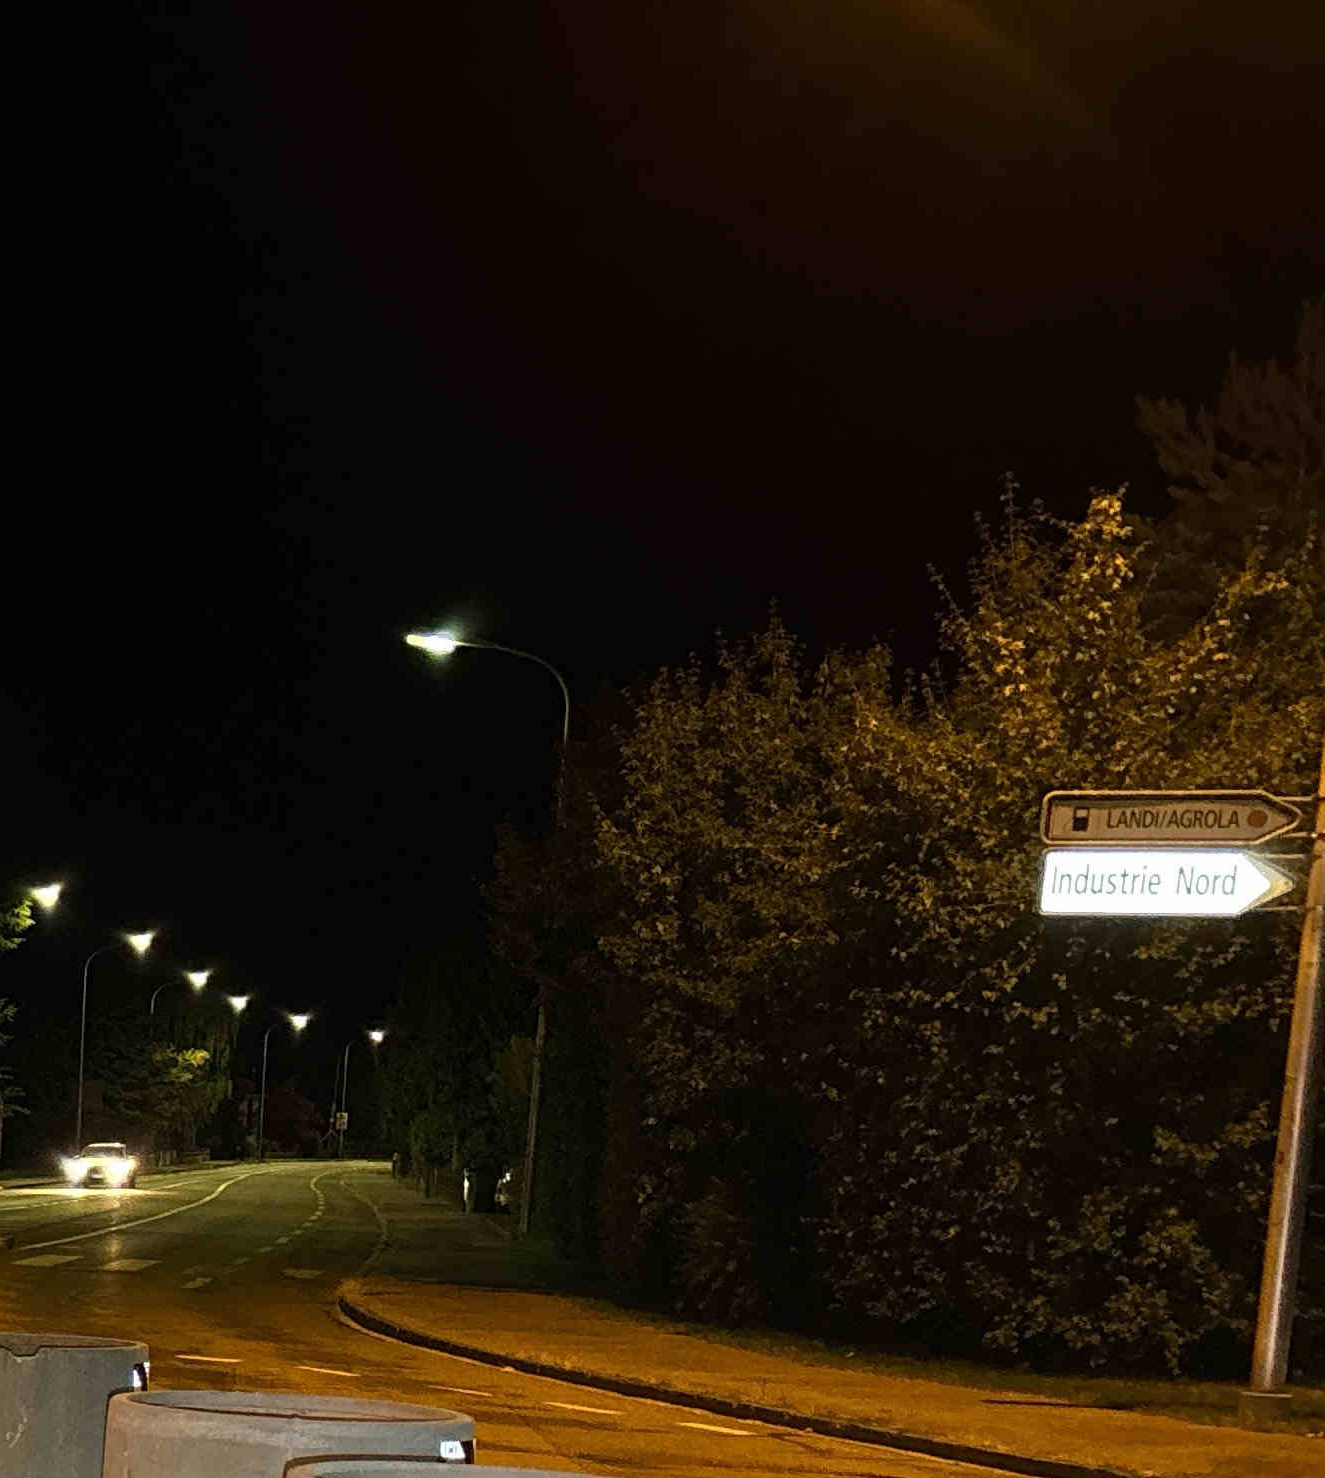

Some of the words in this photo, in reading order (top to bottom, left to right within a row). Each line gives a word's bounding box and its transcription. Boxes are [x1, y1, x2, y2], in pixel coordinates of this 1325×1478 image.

[1106, 809, 1239, 829] LANDI/AGROLA
[1051, 864, 1162, 895] Industrie
[1176, 864, 1238, 896] Nord
